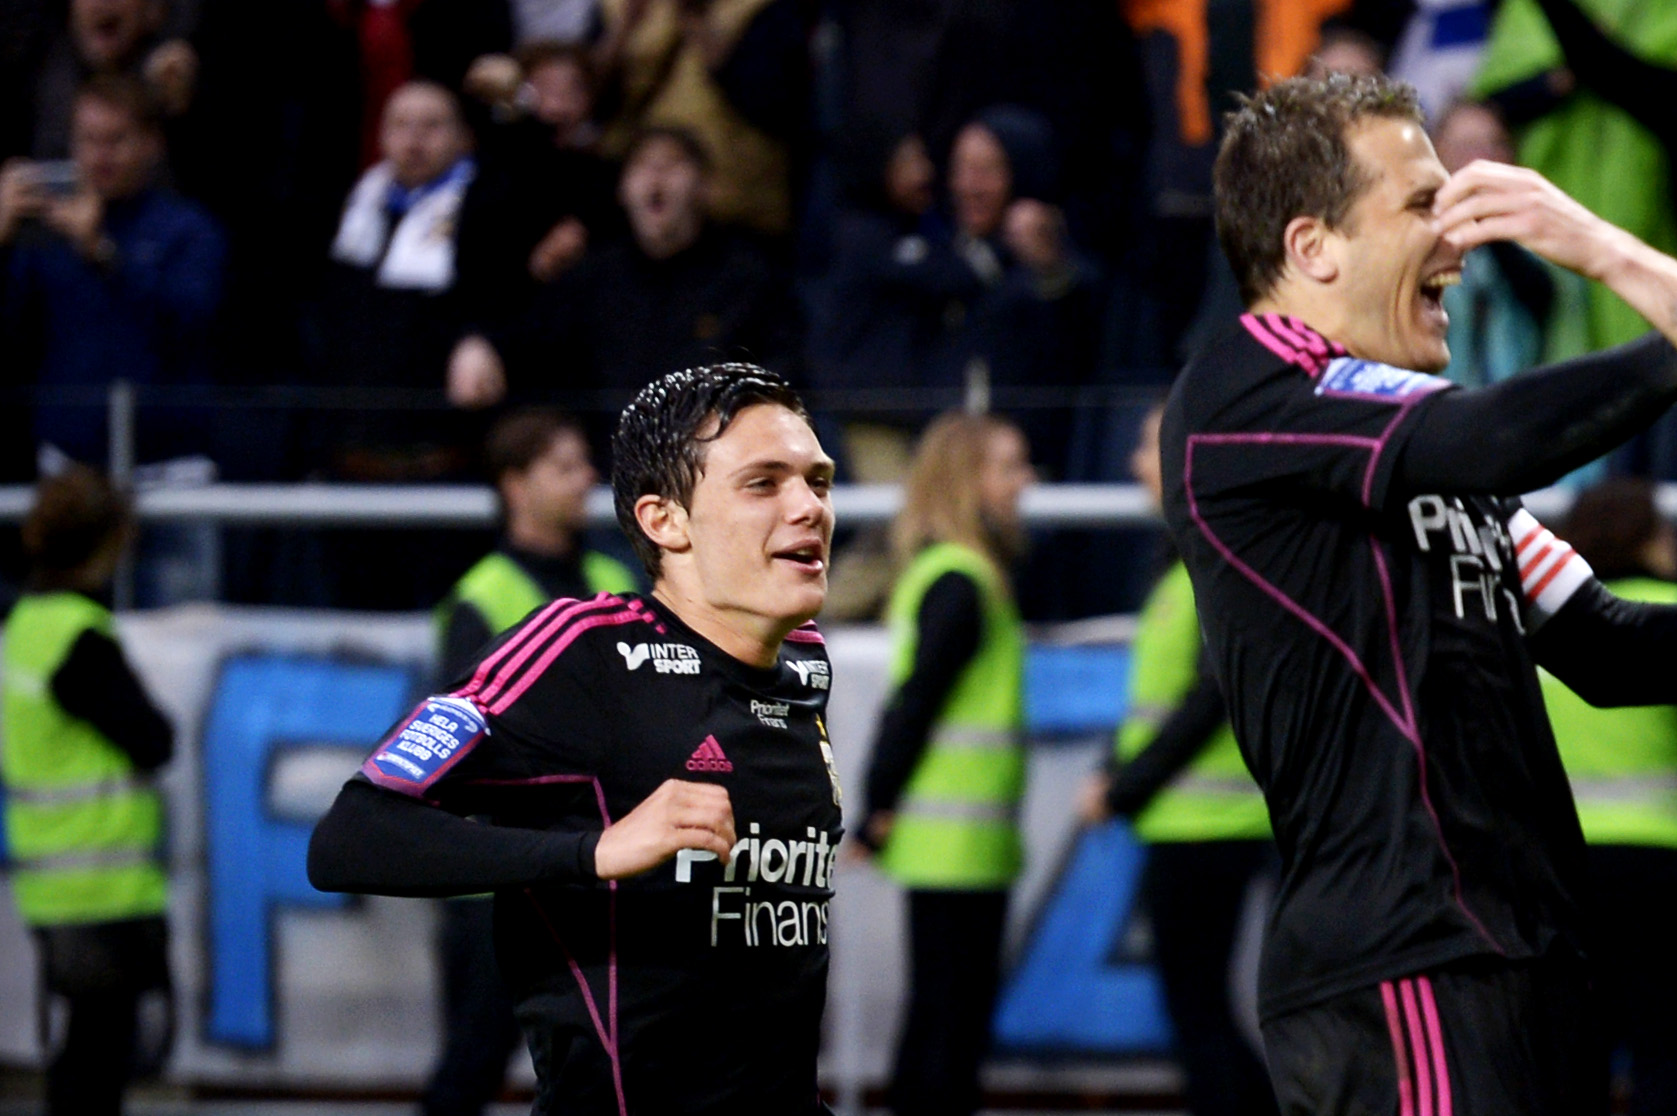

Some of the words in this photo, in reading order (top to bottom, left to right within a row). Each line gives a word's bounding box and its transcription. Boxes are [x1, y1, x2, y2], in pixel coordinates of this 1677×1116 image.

[651, 643, 699, 660] INTER
[653, 659, 702, 675] SPORT
[686, 758, 733, 773] adidas
